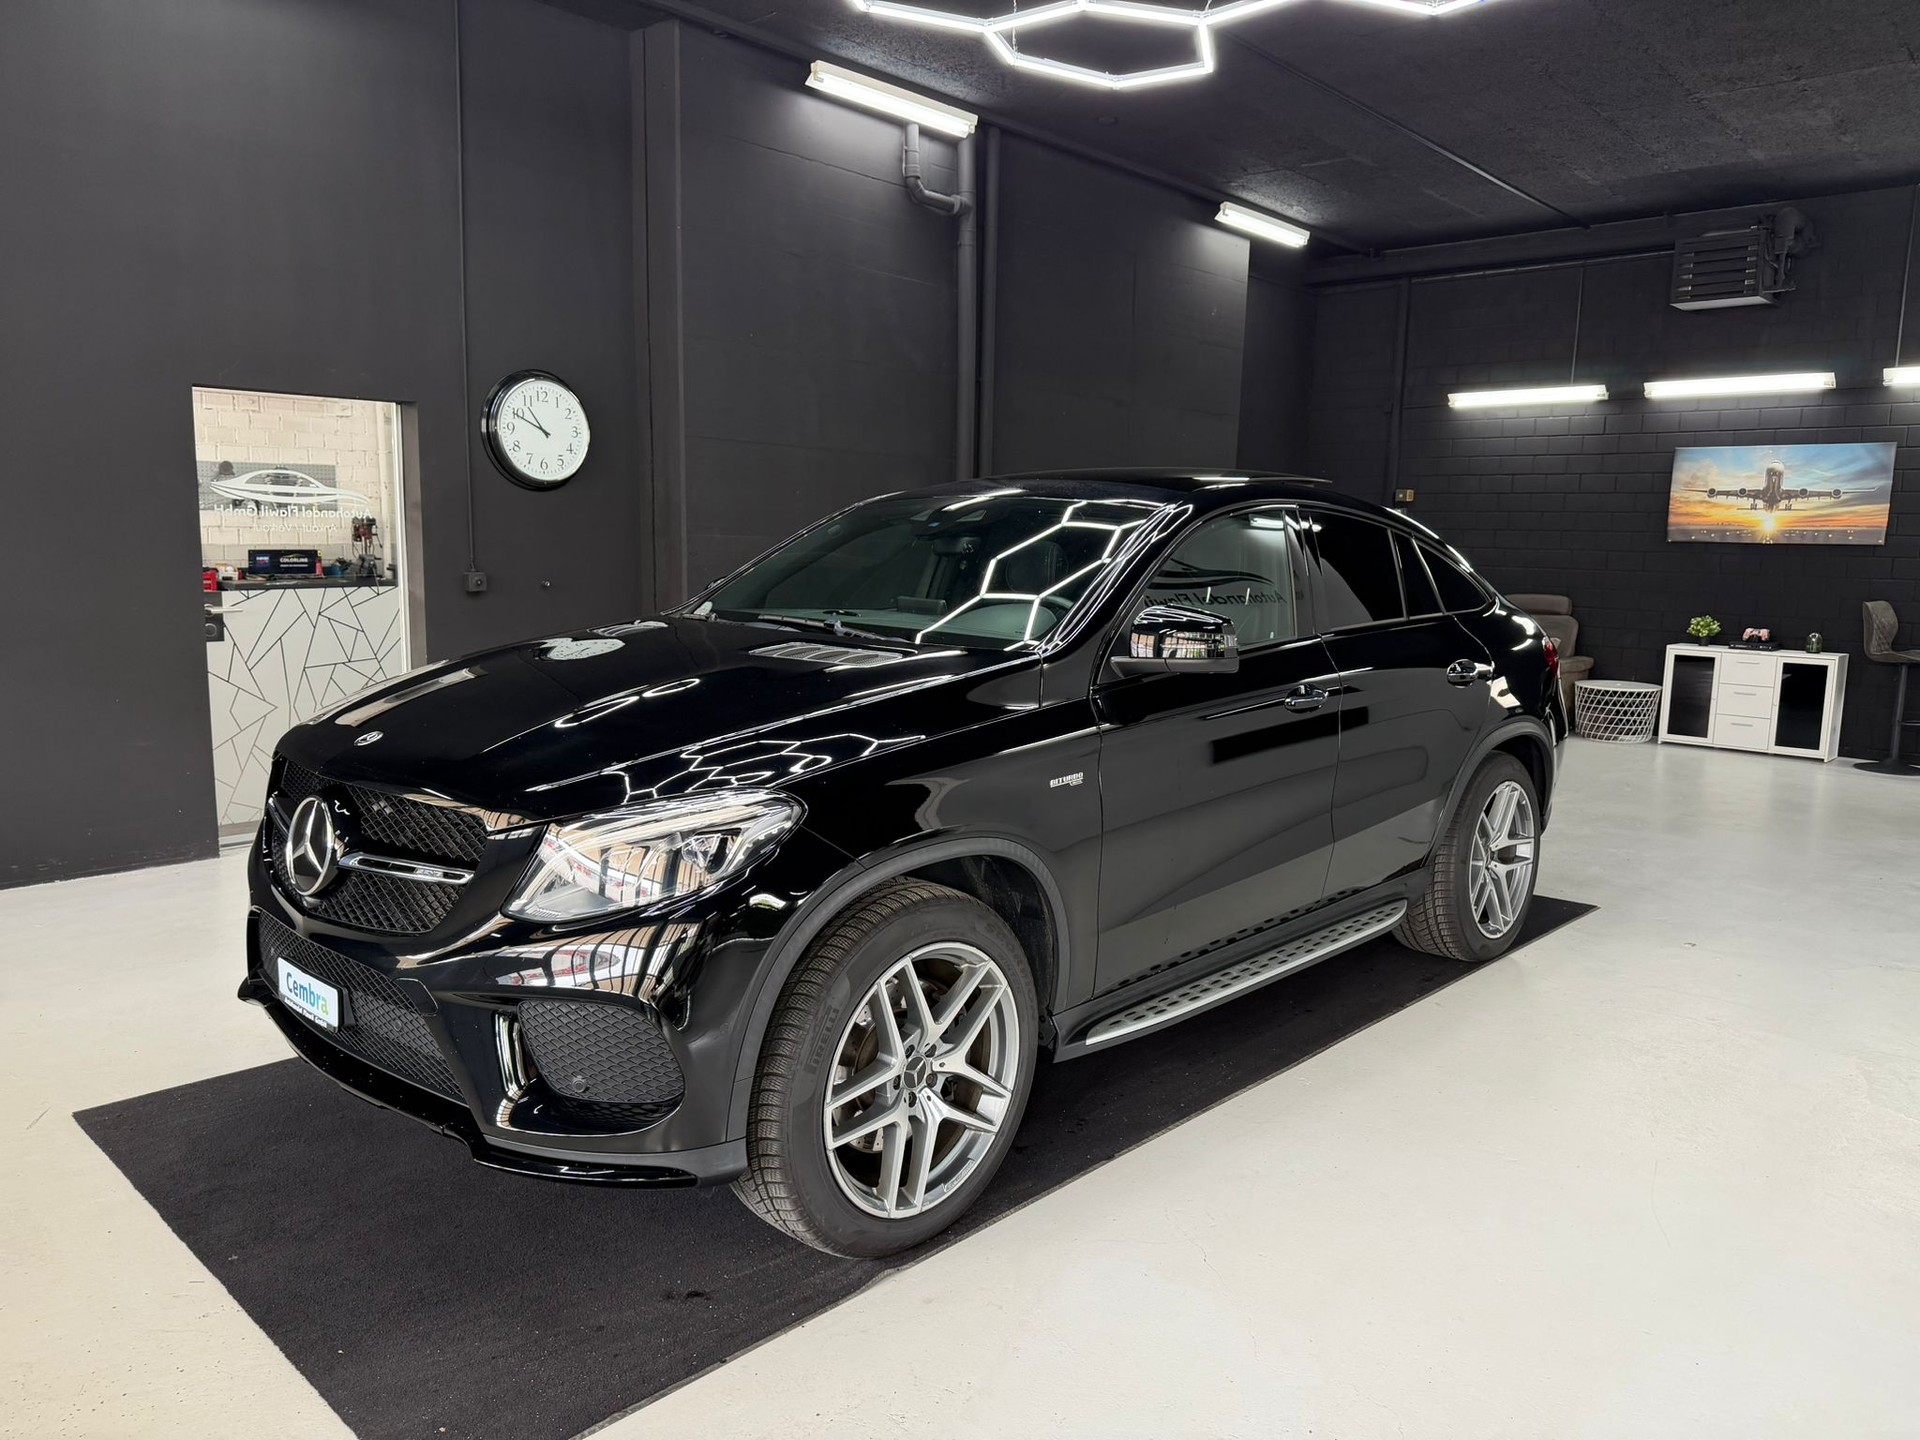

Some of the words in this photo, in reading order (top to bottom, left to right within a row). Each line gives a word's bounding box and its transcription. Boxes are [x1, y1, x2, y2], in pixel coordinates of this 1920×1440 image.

[523, 394, 533, 407] 11
[536, 390, 548, 403] 12
[512, 407, 524, 419] 10
[564, 408, 572, 420] 2
[506, 422, 515, 434] 9
[571, 426, 579, 438] 3
[512, 440, 521, 452] 8
[566, 442, 574, 454] 4
[526, 452, 534, 465] 7
[540, 457, 548, 470] 6
[557, 454, 564, 466] 5
[1050, 772, 1084, 788] BITURBO
[286, 971, 330, 1016] Cembra
[804, 1004, 840, 1074] PIRELLI
